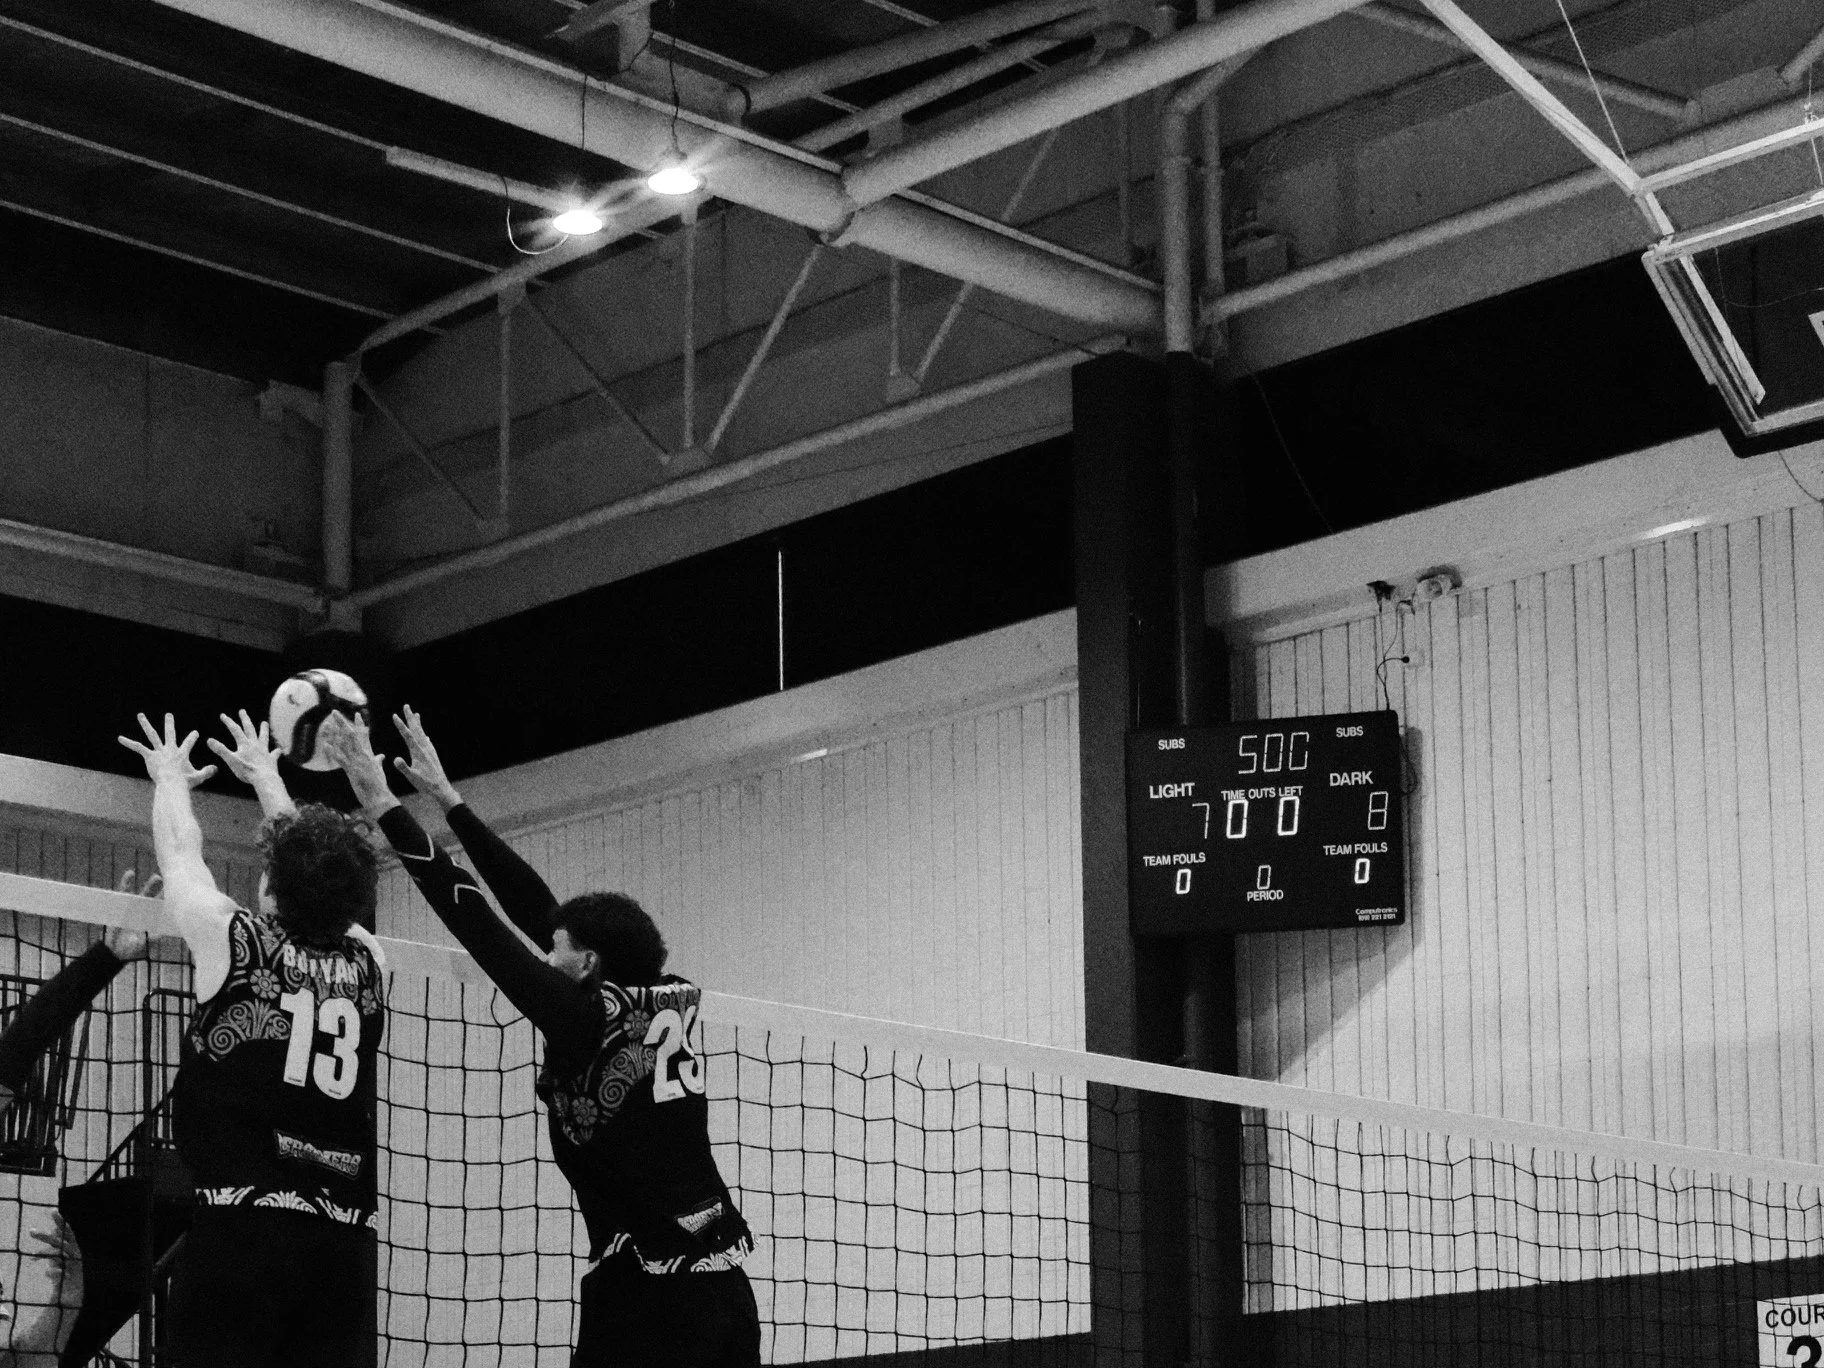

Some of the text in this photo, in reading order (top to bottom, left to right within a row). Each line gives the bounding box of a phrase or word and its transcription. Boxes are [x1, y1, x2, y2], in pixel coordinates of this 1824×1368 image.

[1336, 726, 1364, 738] SUBS
[1158, 738, 1186, 750] SUBS
[1329, 770, 1374, 787] DARK
[1149, 782, 1195, 799] LIGHT
[1221, 785, 1304, 801] TIME OUTS LEFT
[1226, 796, 1300, 839] 0 0
[1367, 791, 1389, 830] 8
[1192, 802, 1210, 840] 7
[1323, 842, 1388, 856] TEAM FOULS
[1143, 852, 1206, 867] TEAM FOULS
[1256, 865, 1271, 890] 0
[1354, 858, 1370, 884] 0
[1175, 868, 1192, 895] 0
[1246, 889, 1284, 902] PERIOD
[280, 986, 361, 1100] 13
